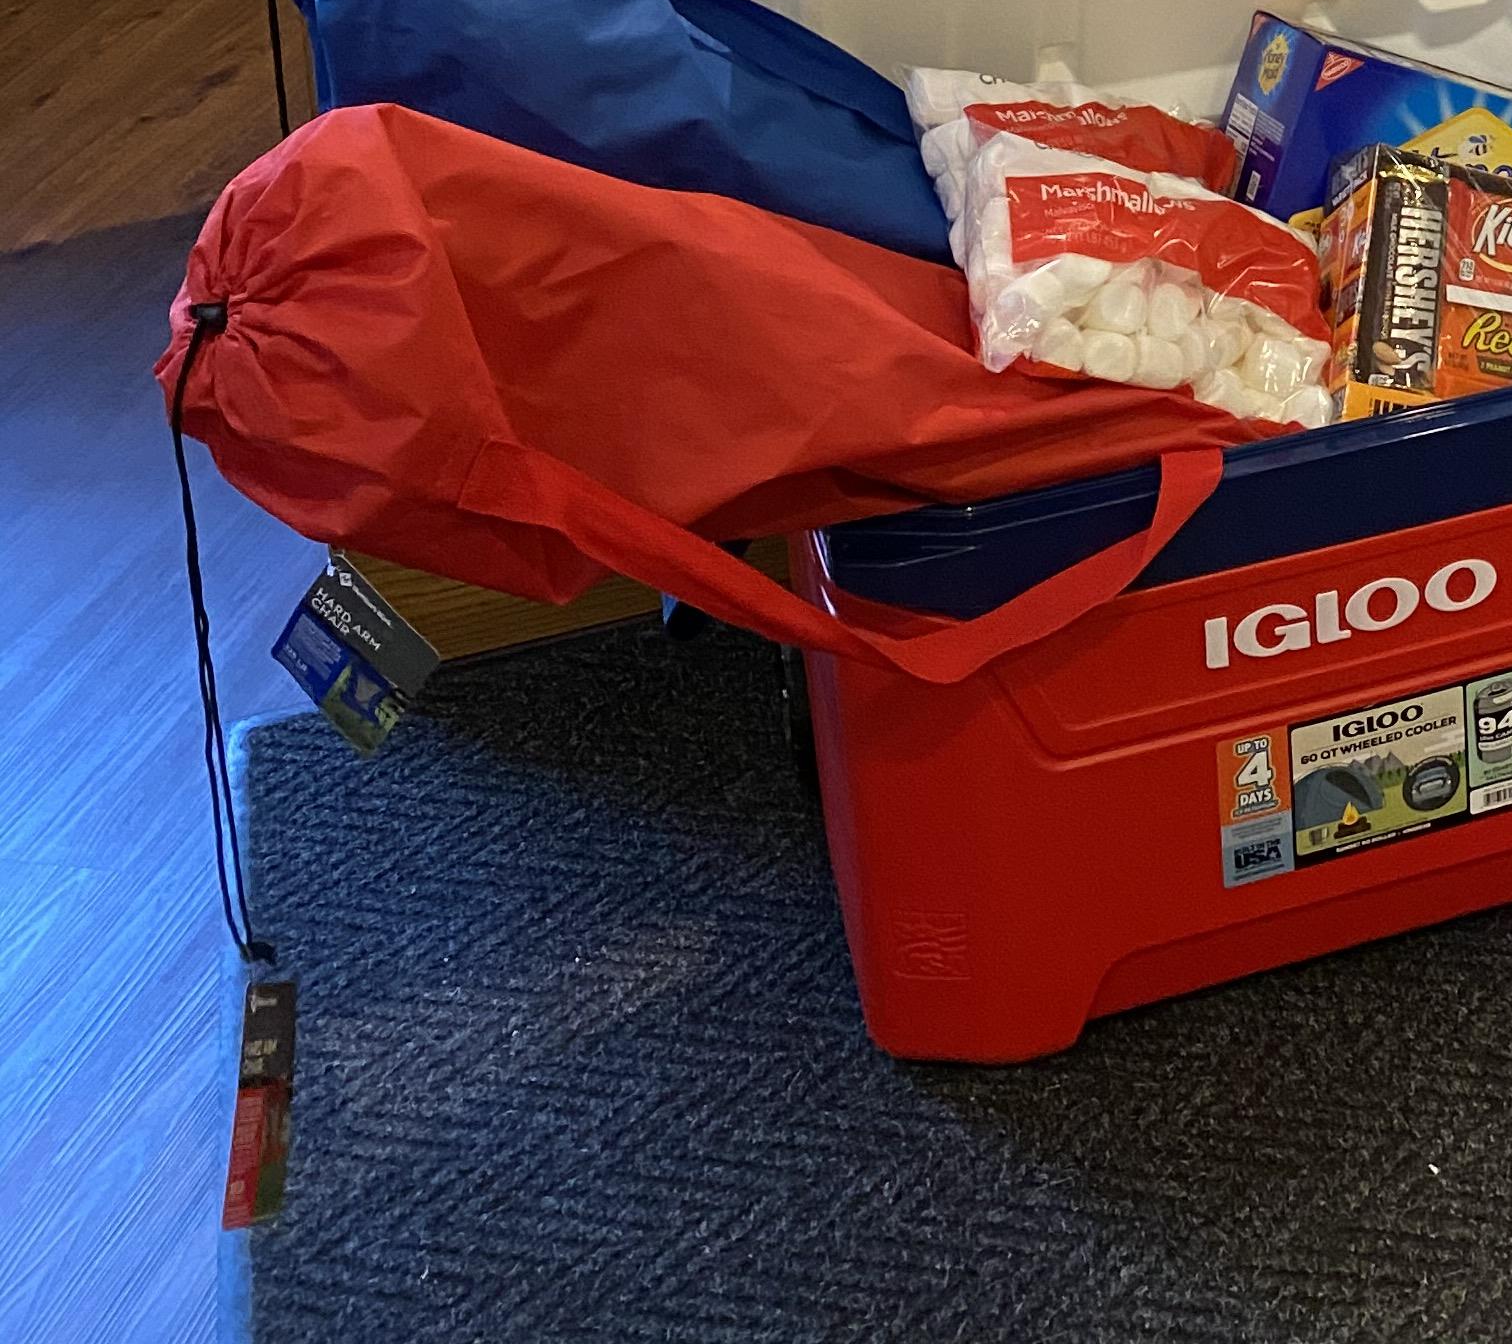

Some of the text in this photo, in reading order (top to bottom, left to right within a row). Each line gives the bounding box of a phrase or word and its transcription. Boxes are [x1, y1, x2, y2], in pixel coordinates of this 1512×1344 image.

[311, 597, 350, 636] CHAIR
[315, 587, 352, 624] HARD
[351, 624, 382, 652] ARM
[1204, 558, 1497, 669] IGLOO
[1320, 746, 1341, 760] QT
[1340, 731, 1403, 756] WHEELED
[1405, 715, 1457, 738] COOLER
[1332, 703, 1424, 742] IGLOO
[1237, 738, 1268, 754] UP TO
[1238, 750, 1273, 788] 4
[1239, 788, 1273, 807] DAYS
[1234, 845, 1283, 870] USA
